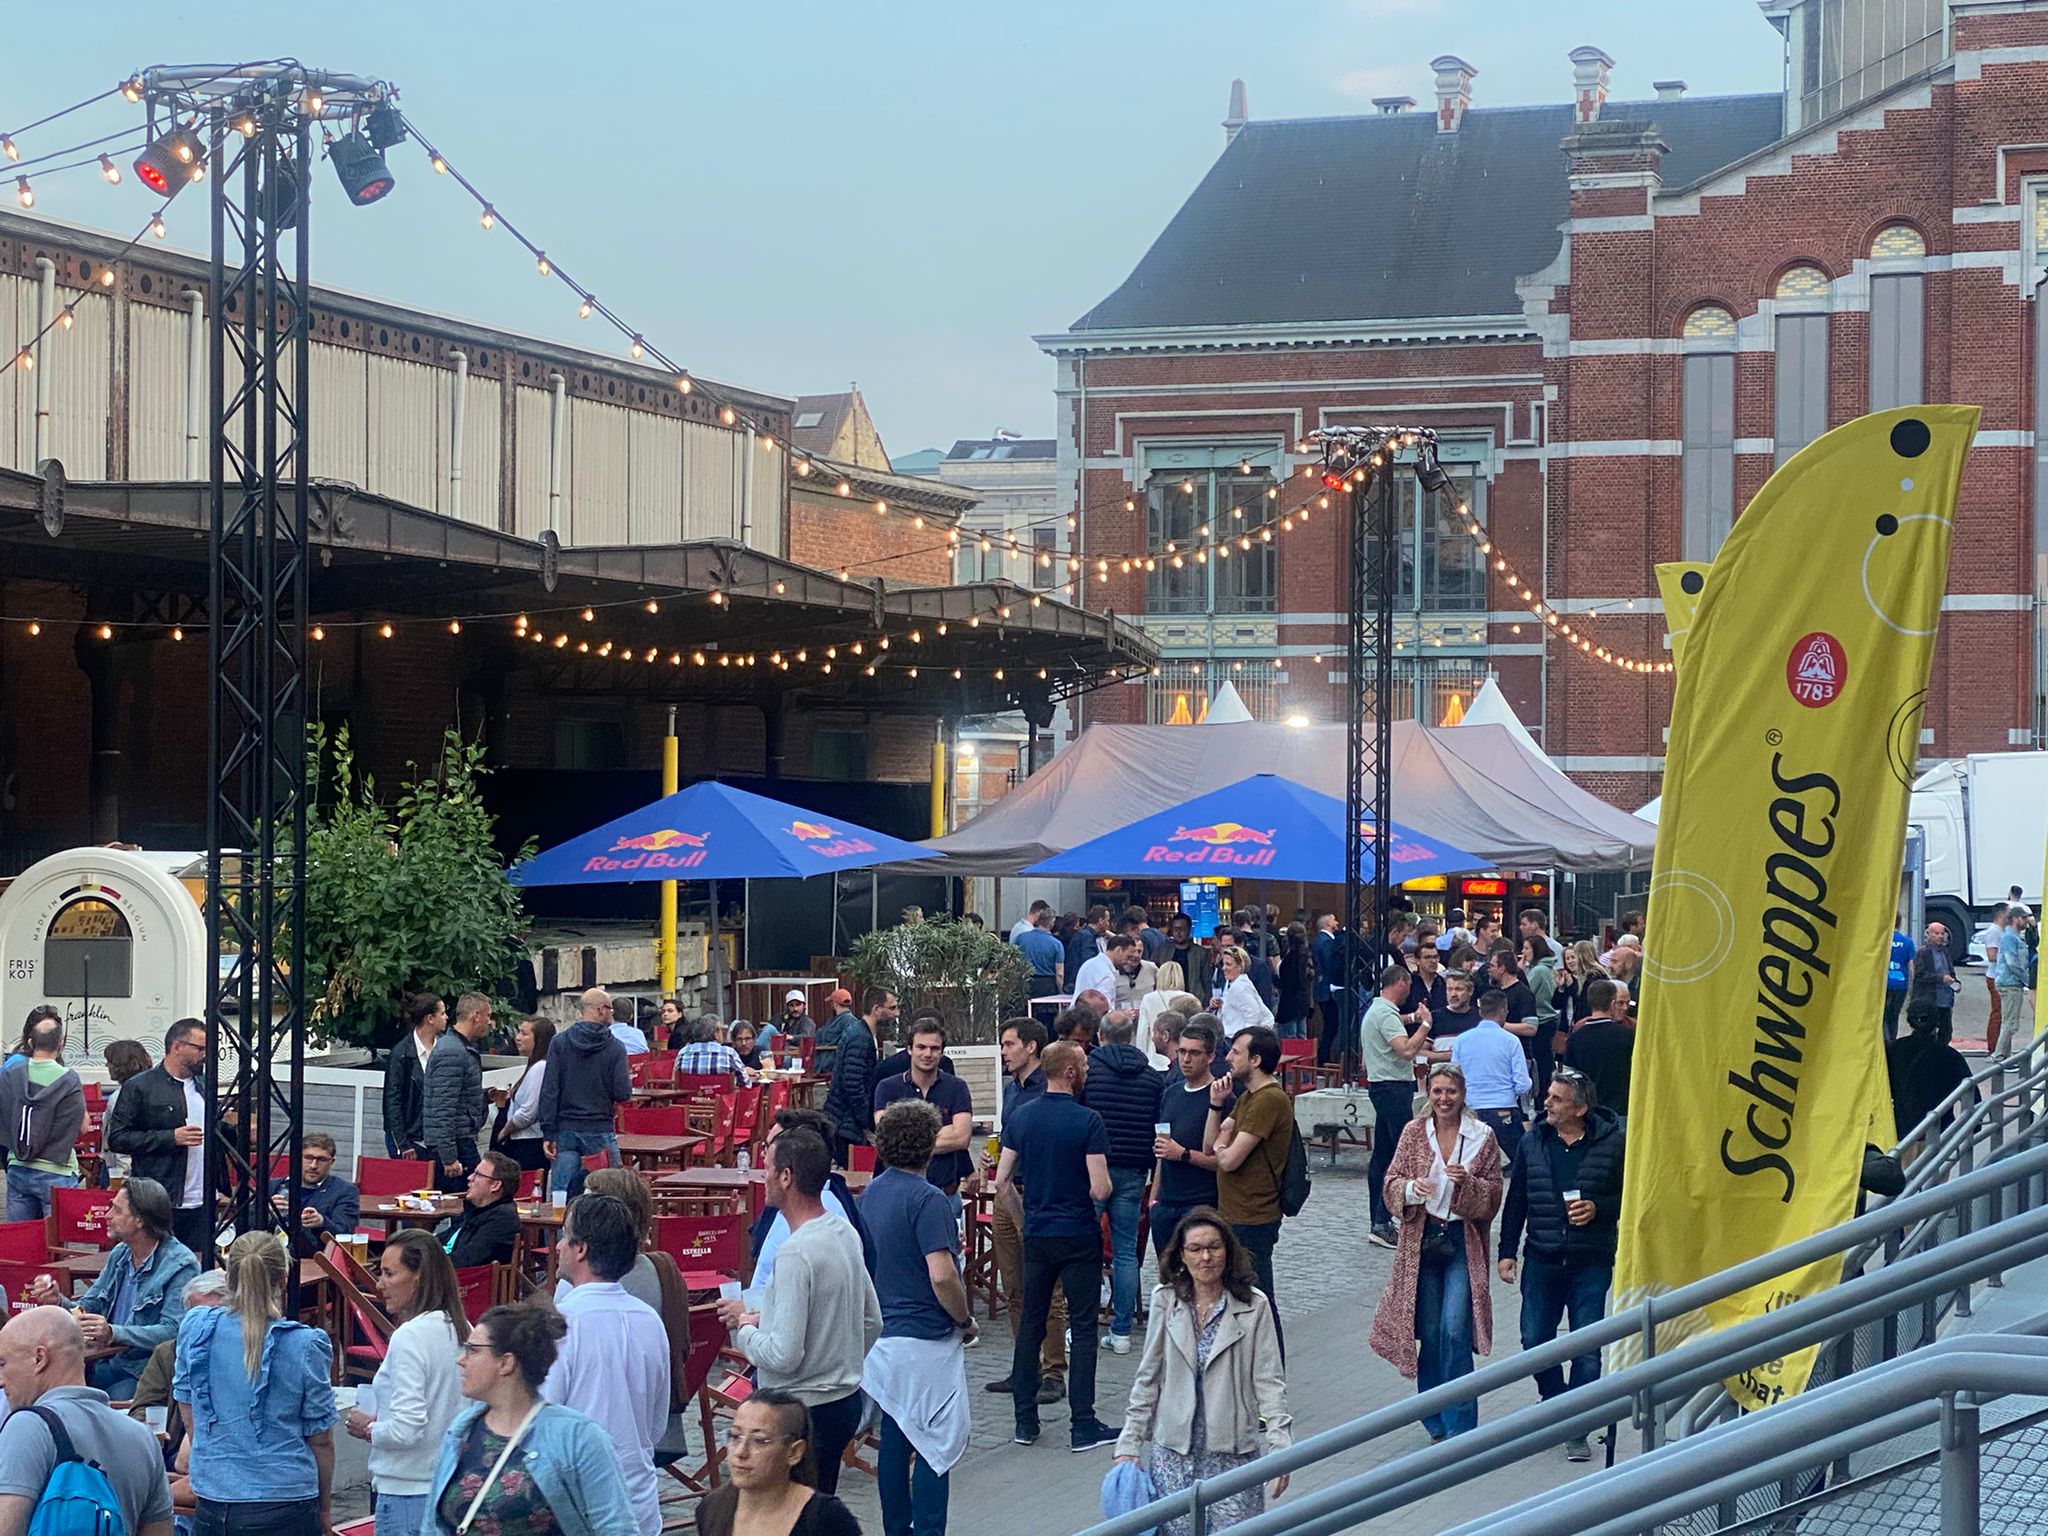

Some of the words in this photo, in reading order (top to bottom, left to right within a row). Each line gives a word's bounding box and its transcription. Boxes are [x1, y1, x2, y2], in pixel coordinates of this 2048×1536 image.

[1796, 682, 1833, 701] 1783
[582, 852, 647, 872] Red
[643, 850, 708, 868] Bull
[1143, 845, 1211, 863] Red
[1210, 846, 1276, 866] Bull
[33, 913, 47, 941] MADE
[48, 899, 58, 910] IN
[122, 899, 148, 941] BELGIUM
[9, 970, 35, 979] KOT
[1720, 751, 1841, 1204] Schweppes
[1344, 1103, 1358, 1127] 3
